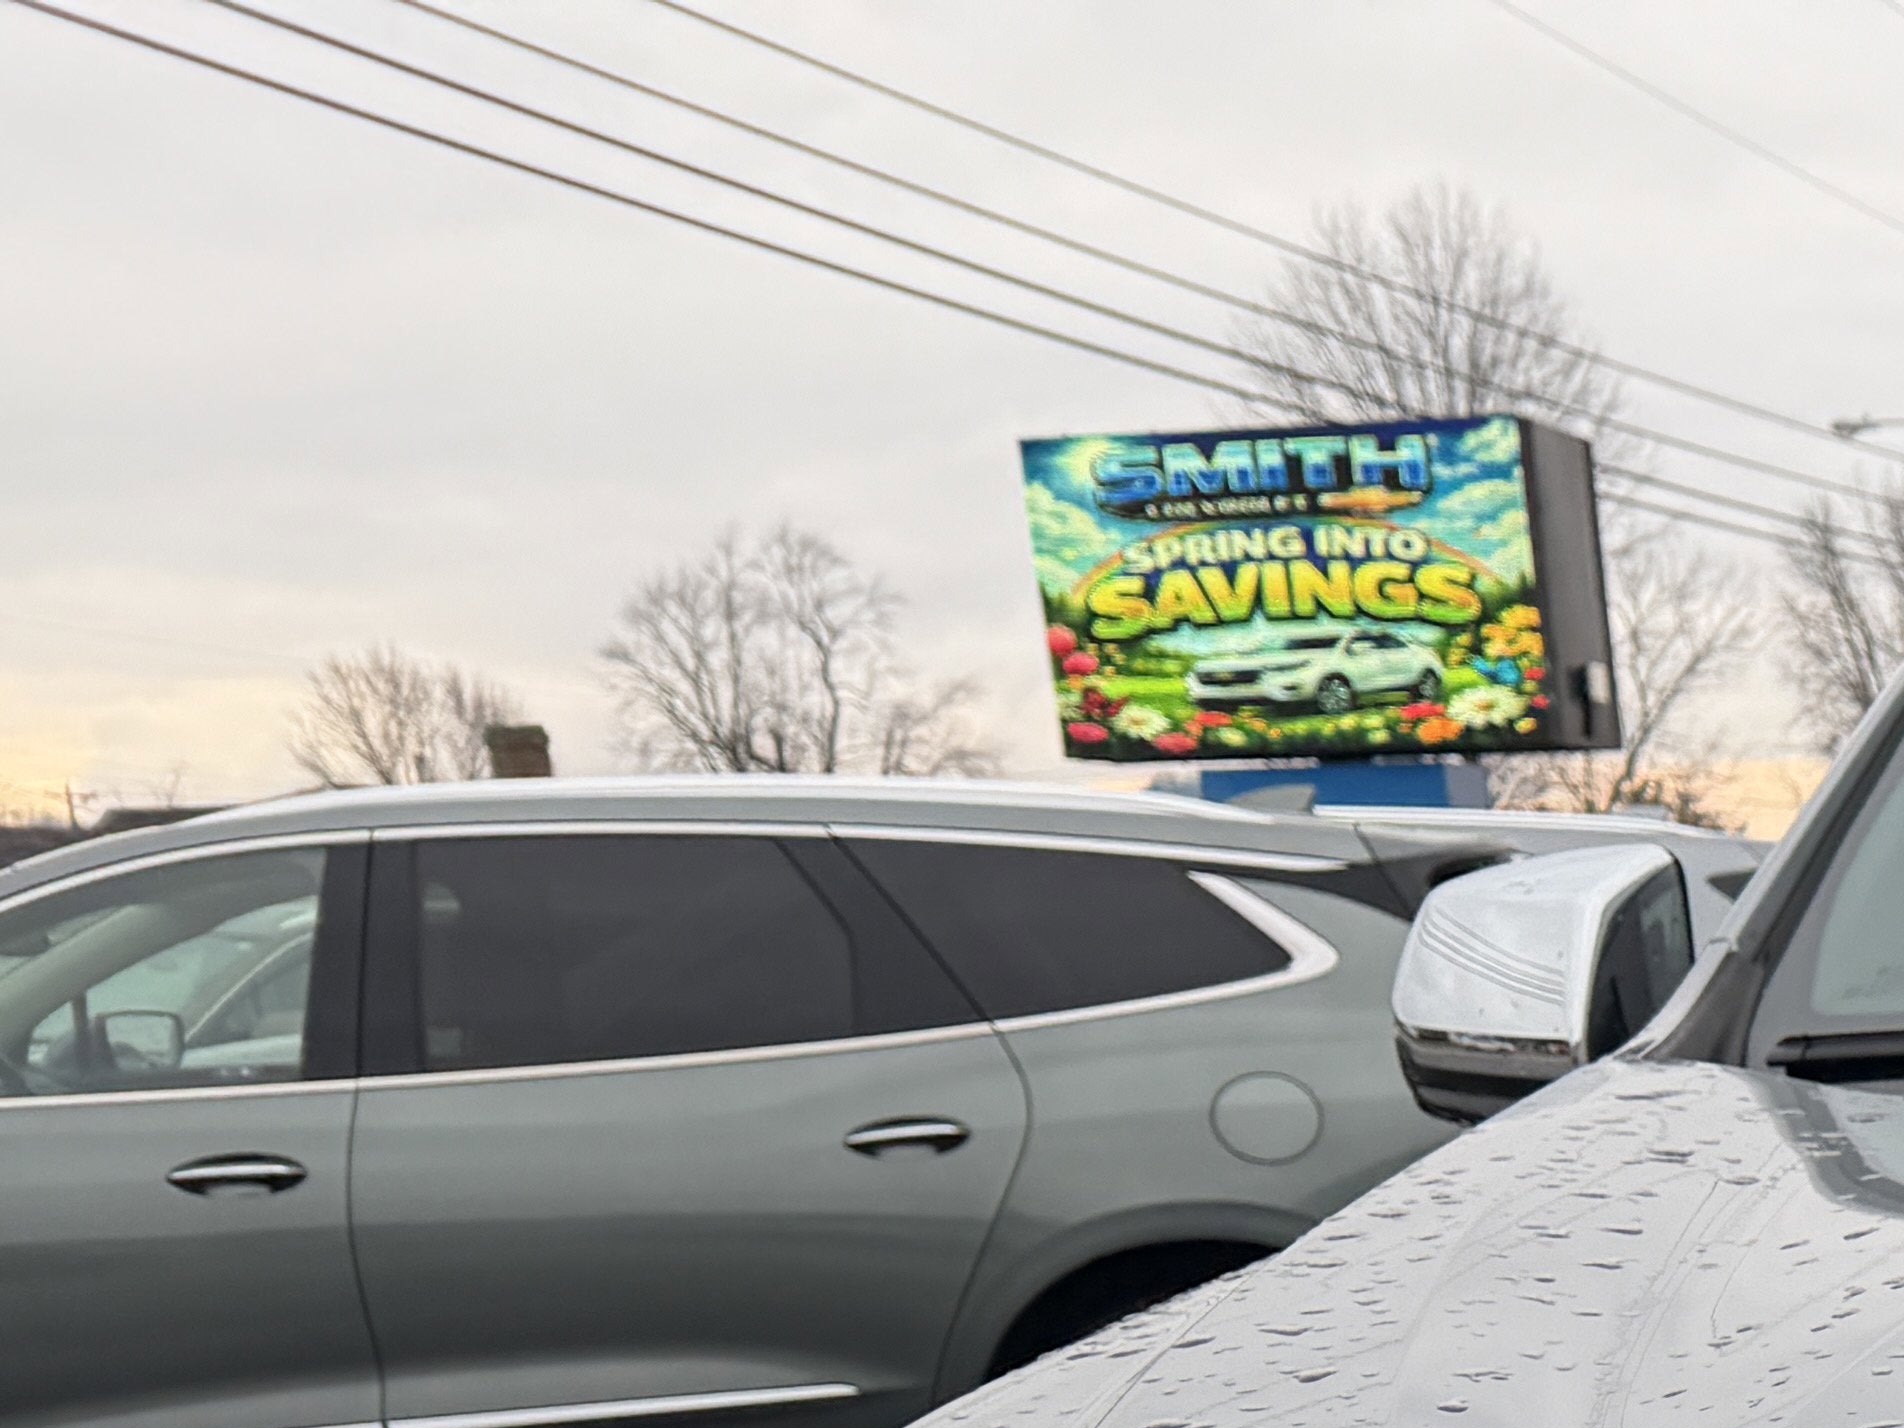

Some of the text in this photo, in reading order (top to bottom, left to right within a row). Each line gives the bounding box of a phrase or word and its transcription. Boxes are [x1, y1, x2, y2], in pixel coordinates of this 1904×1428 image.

[1091, 433, 1433, 504] SMITH
[1121, 525, 1430, 575] SPRING INTO
[1085, 559, 1483, 641] SAVINGS
